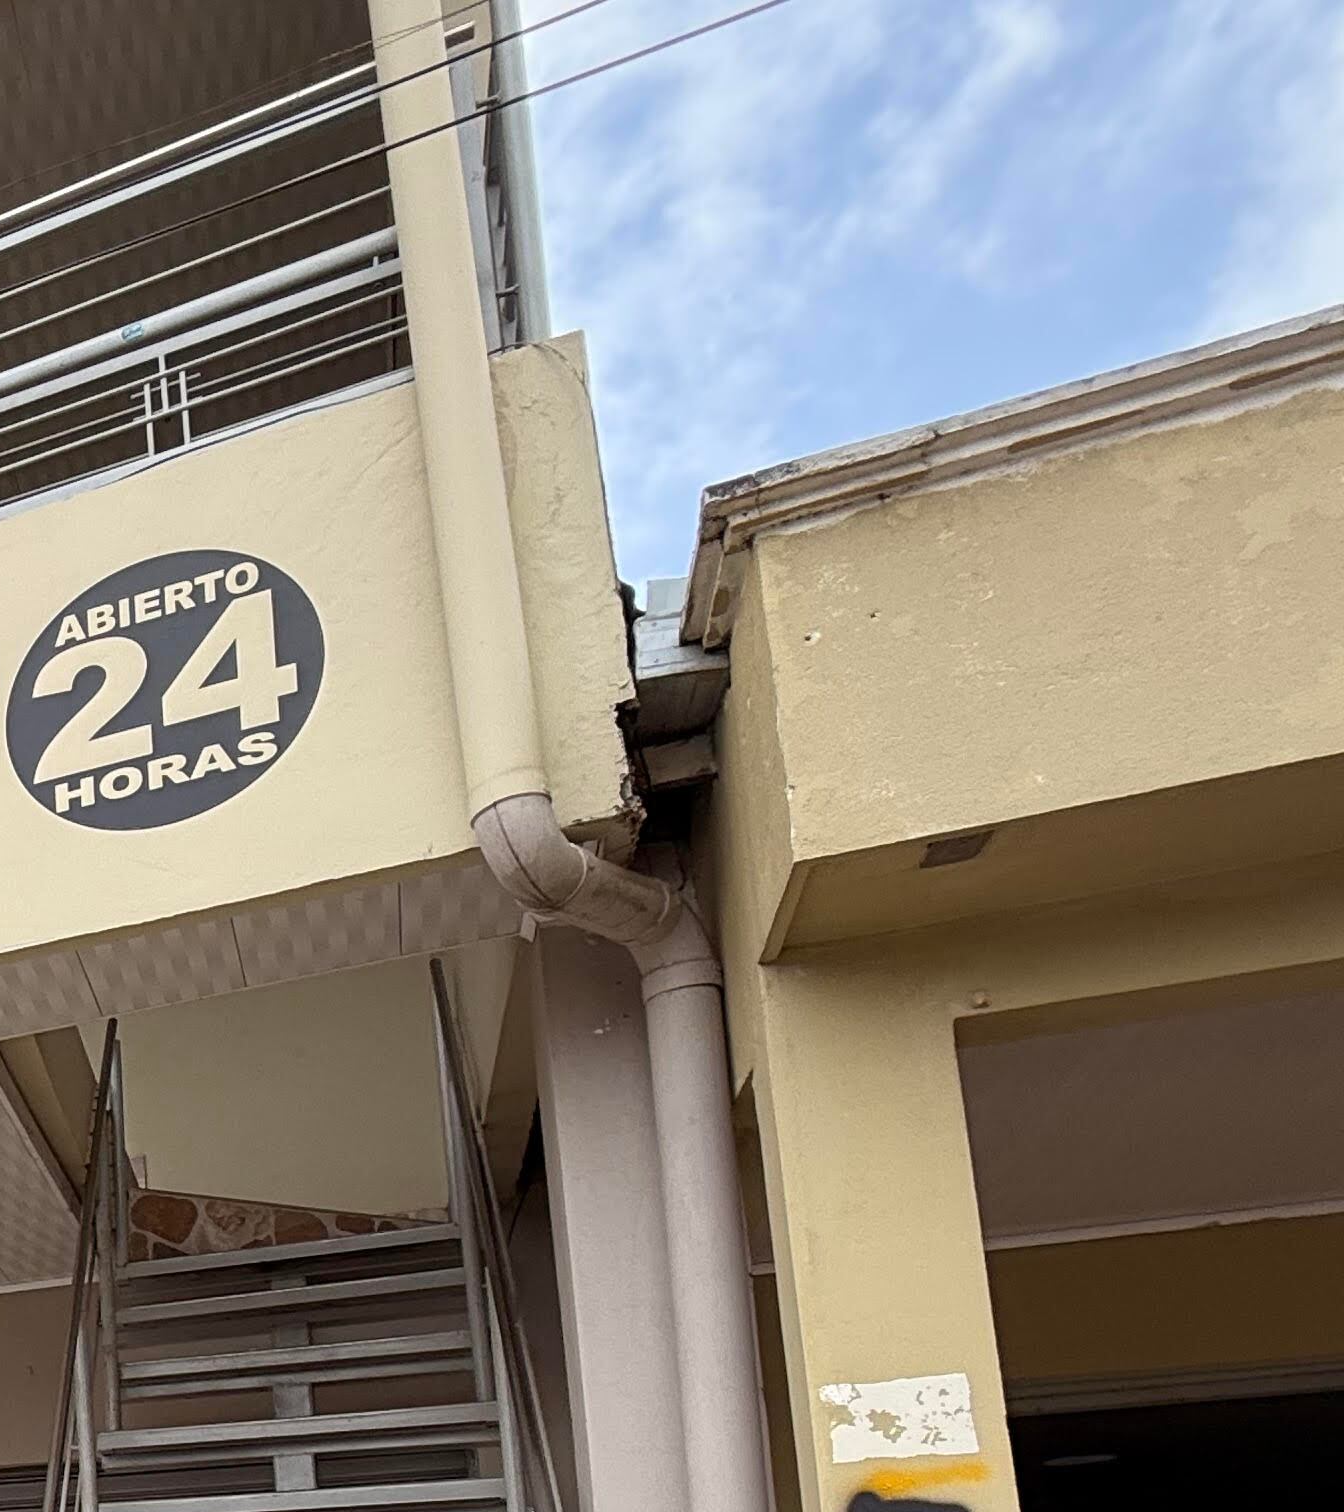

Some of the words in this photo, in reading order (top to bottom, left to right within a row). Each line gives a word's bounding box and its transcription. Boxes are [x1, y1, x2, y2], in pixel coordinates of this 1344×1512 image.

[54, 561, 260, 649] ABIERTO
[31, 588, 299, 786] 24
[53, 730, 280, 814] HORAS
